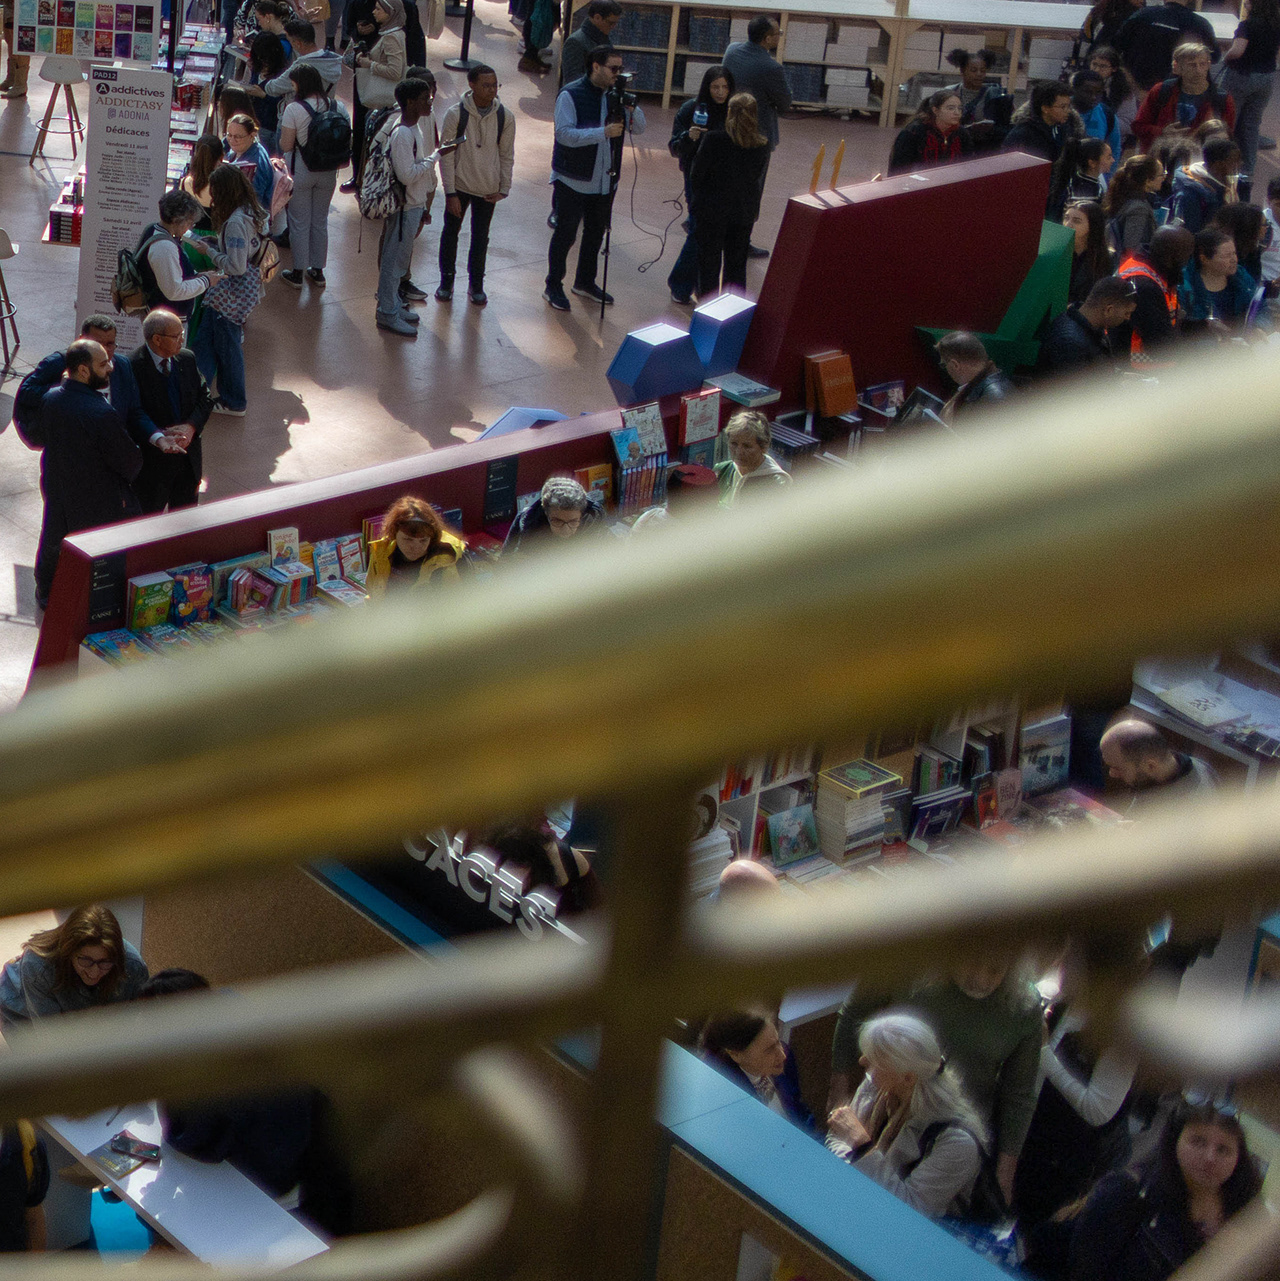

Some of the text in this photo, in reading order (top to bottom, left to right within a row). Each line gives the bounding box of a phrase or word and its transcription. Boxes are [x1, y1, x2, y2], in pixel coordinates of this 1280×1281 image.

[93, 71, 117, 80] PAD12
[111, 85, 165, 98] addictives
[95, 96, 164, 111] ADDICTASY
[118, 111, 150, 121] ADONIA
[105, 125, 150, 137] Dédicaces
[105, 141, 129, 149] Vendredi
